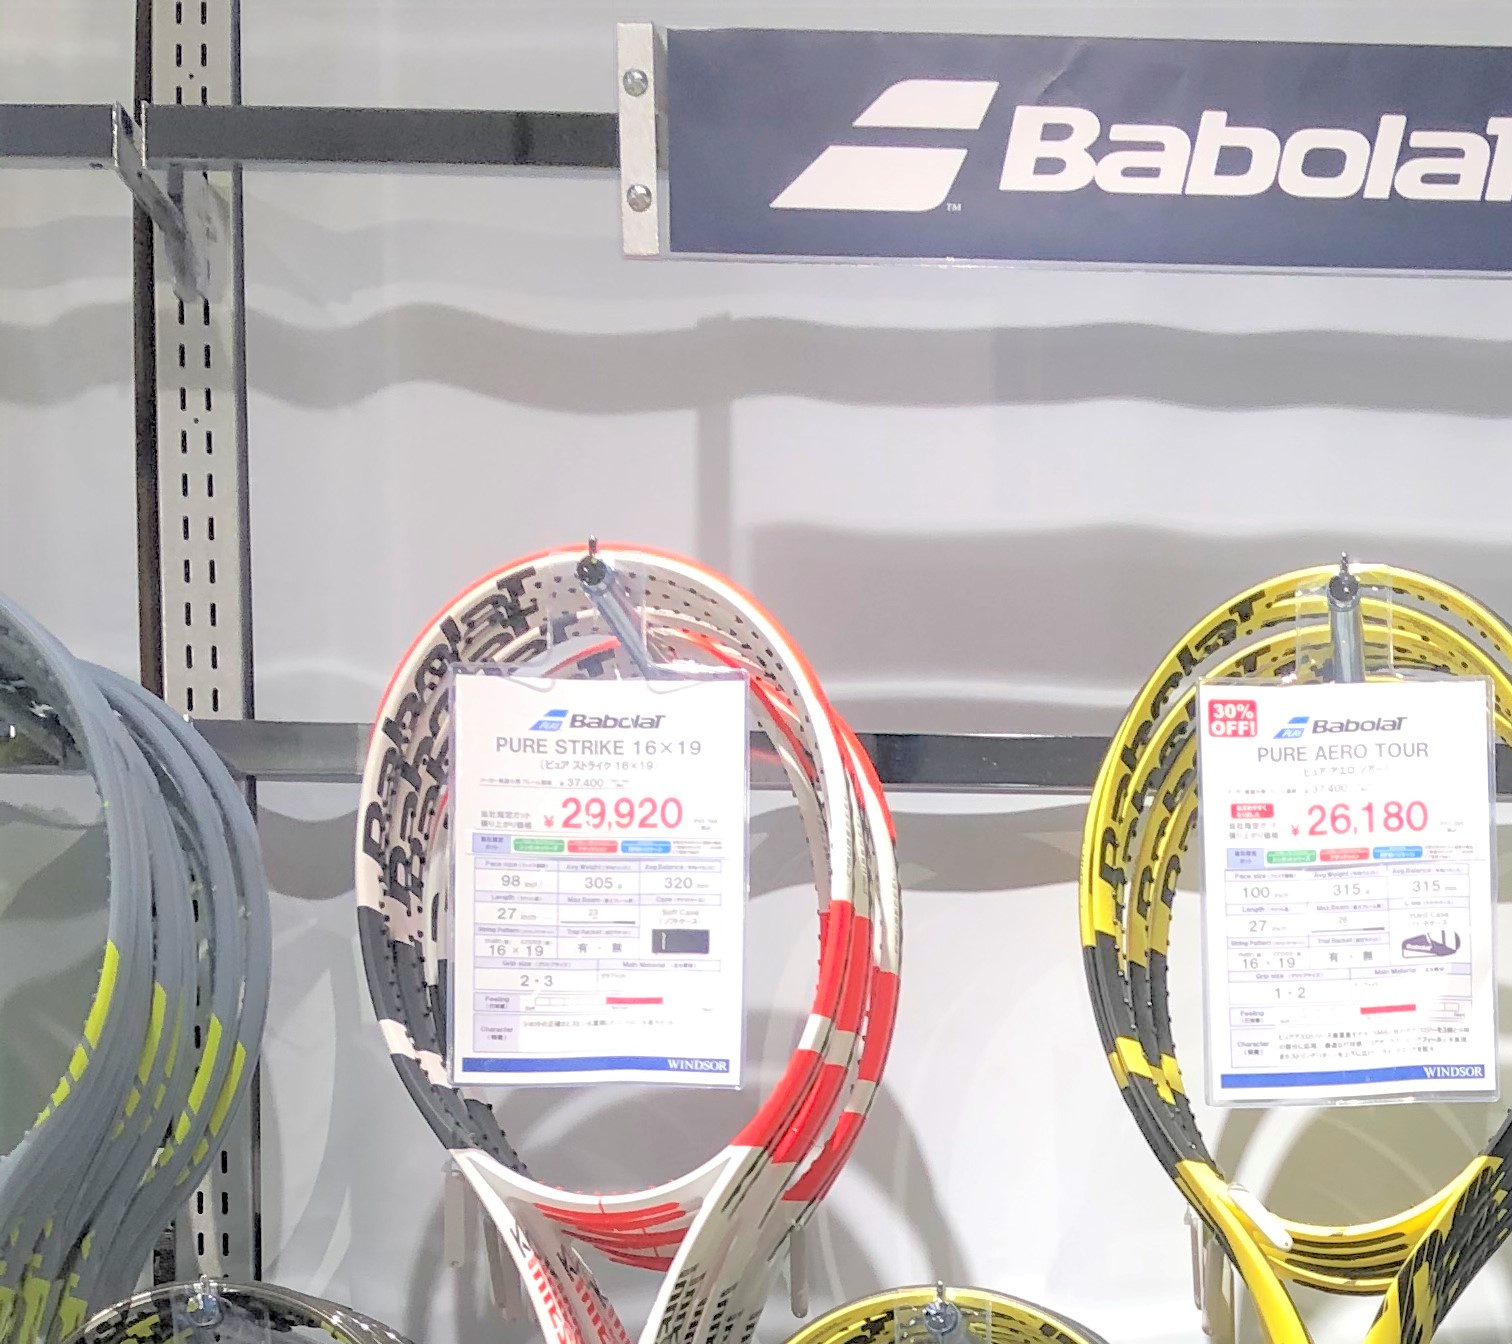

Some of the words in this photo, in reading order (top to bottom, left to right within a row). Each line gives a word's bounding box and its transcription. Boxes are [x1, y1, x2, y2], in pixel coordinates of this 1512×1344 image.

[1213, 704, 1254, 719] 30%
[1211, 721, 1256, 736] OFF!
[496, 737, 547, 754] PURE
[555, 740, 624, 755] STRIKE
[1257, 747, 1307, 762] PURE
[1315, 745, 1367, 761] AERO
[1376, 743, 1428, 758] TOUR
[562, 797, 683, 830] 29,920
[1308, 801, 1428, 836] 26,180
[501, 875, 520, 887] 98
[585, 877, 613, 889] 305
[665, 878, 693, 889] 320
[1413, 880, 1440, 892] 315
[1243, 887, 1270, 898] 100
[1333, 884, 1360, 896] 315
[497, 908, 517, 920] 27
[1249, 921, 1267, 932] 27
[489, 945, 506, 955] 16
[527, 946, 543, 956] 19
[1243, 958, 1258, 968] 16
[1279, 958, 1295, 968] 19
[668, 1059, 727, 1071] WINDSOR
[1423, 1066, 1483, 1078] WINDSOR
